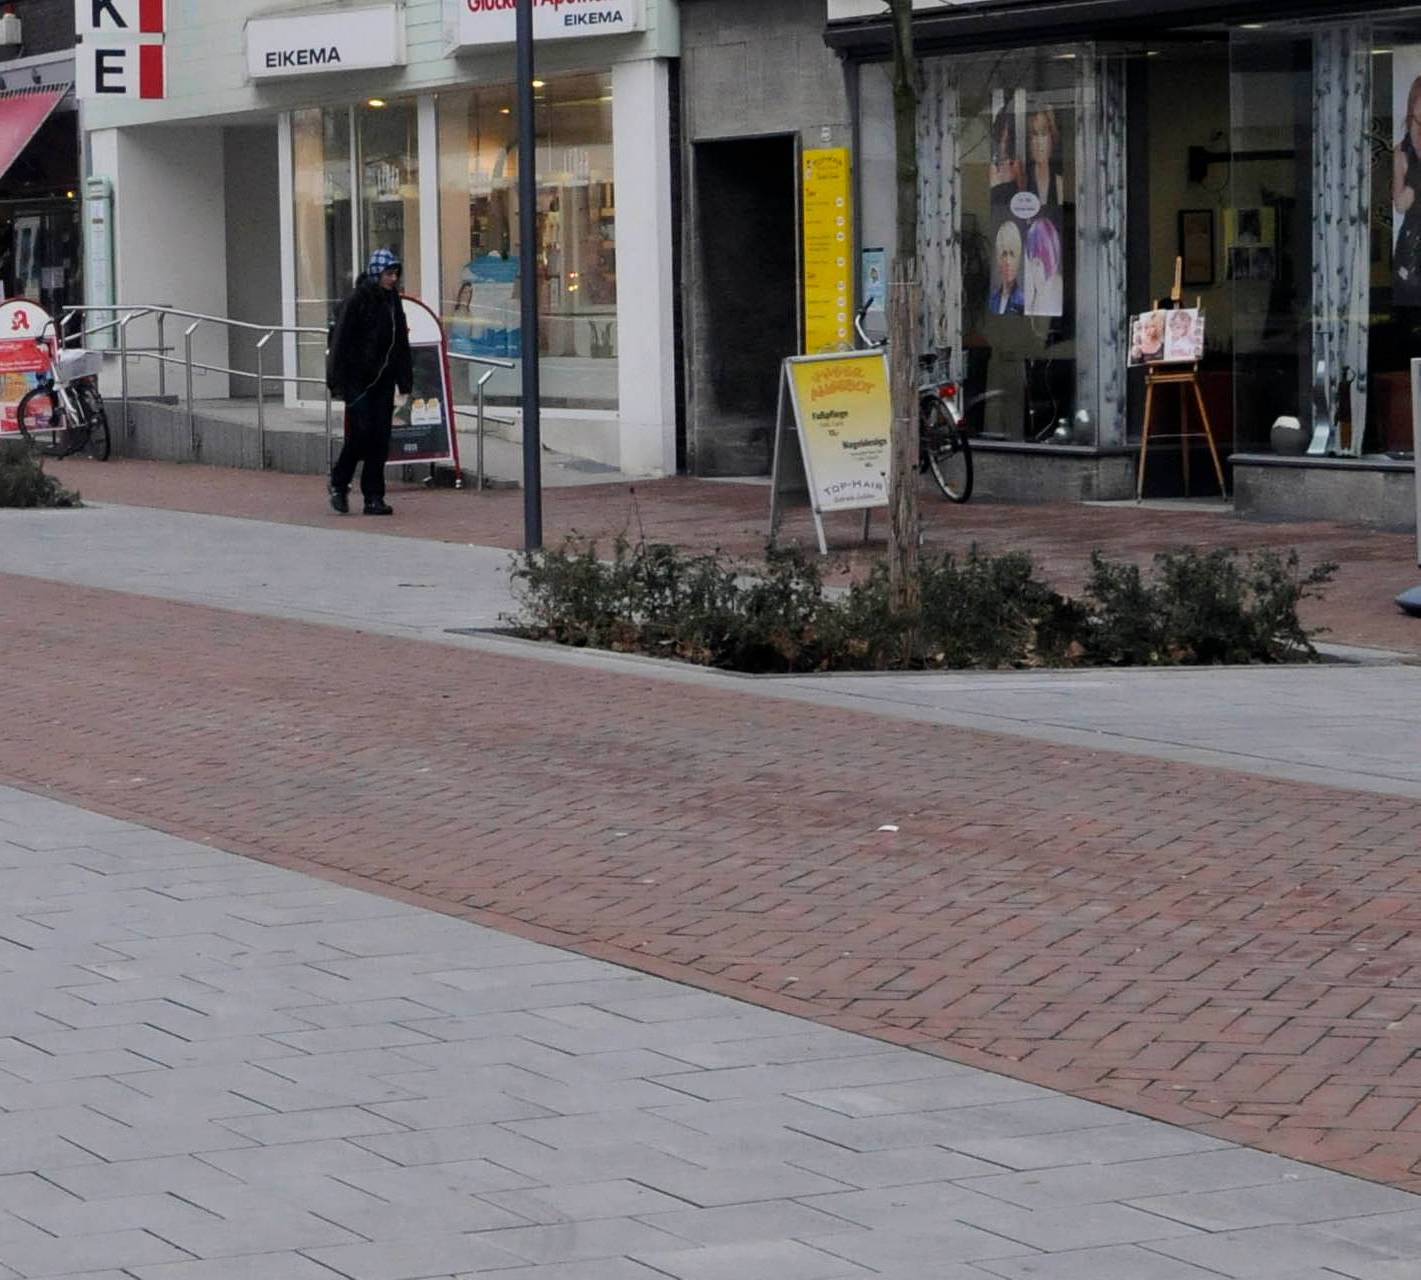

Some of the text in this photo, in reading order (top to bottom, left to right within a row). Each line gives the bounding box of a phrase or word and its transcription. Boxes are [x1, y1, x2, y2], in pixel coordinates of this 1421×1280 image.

[564, 10, 623, 27] EIKEMA
[266, 46, 341, 68] EIKEMA
[823, 479, 883, 496] TOP-HAIR
